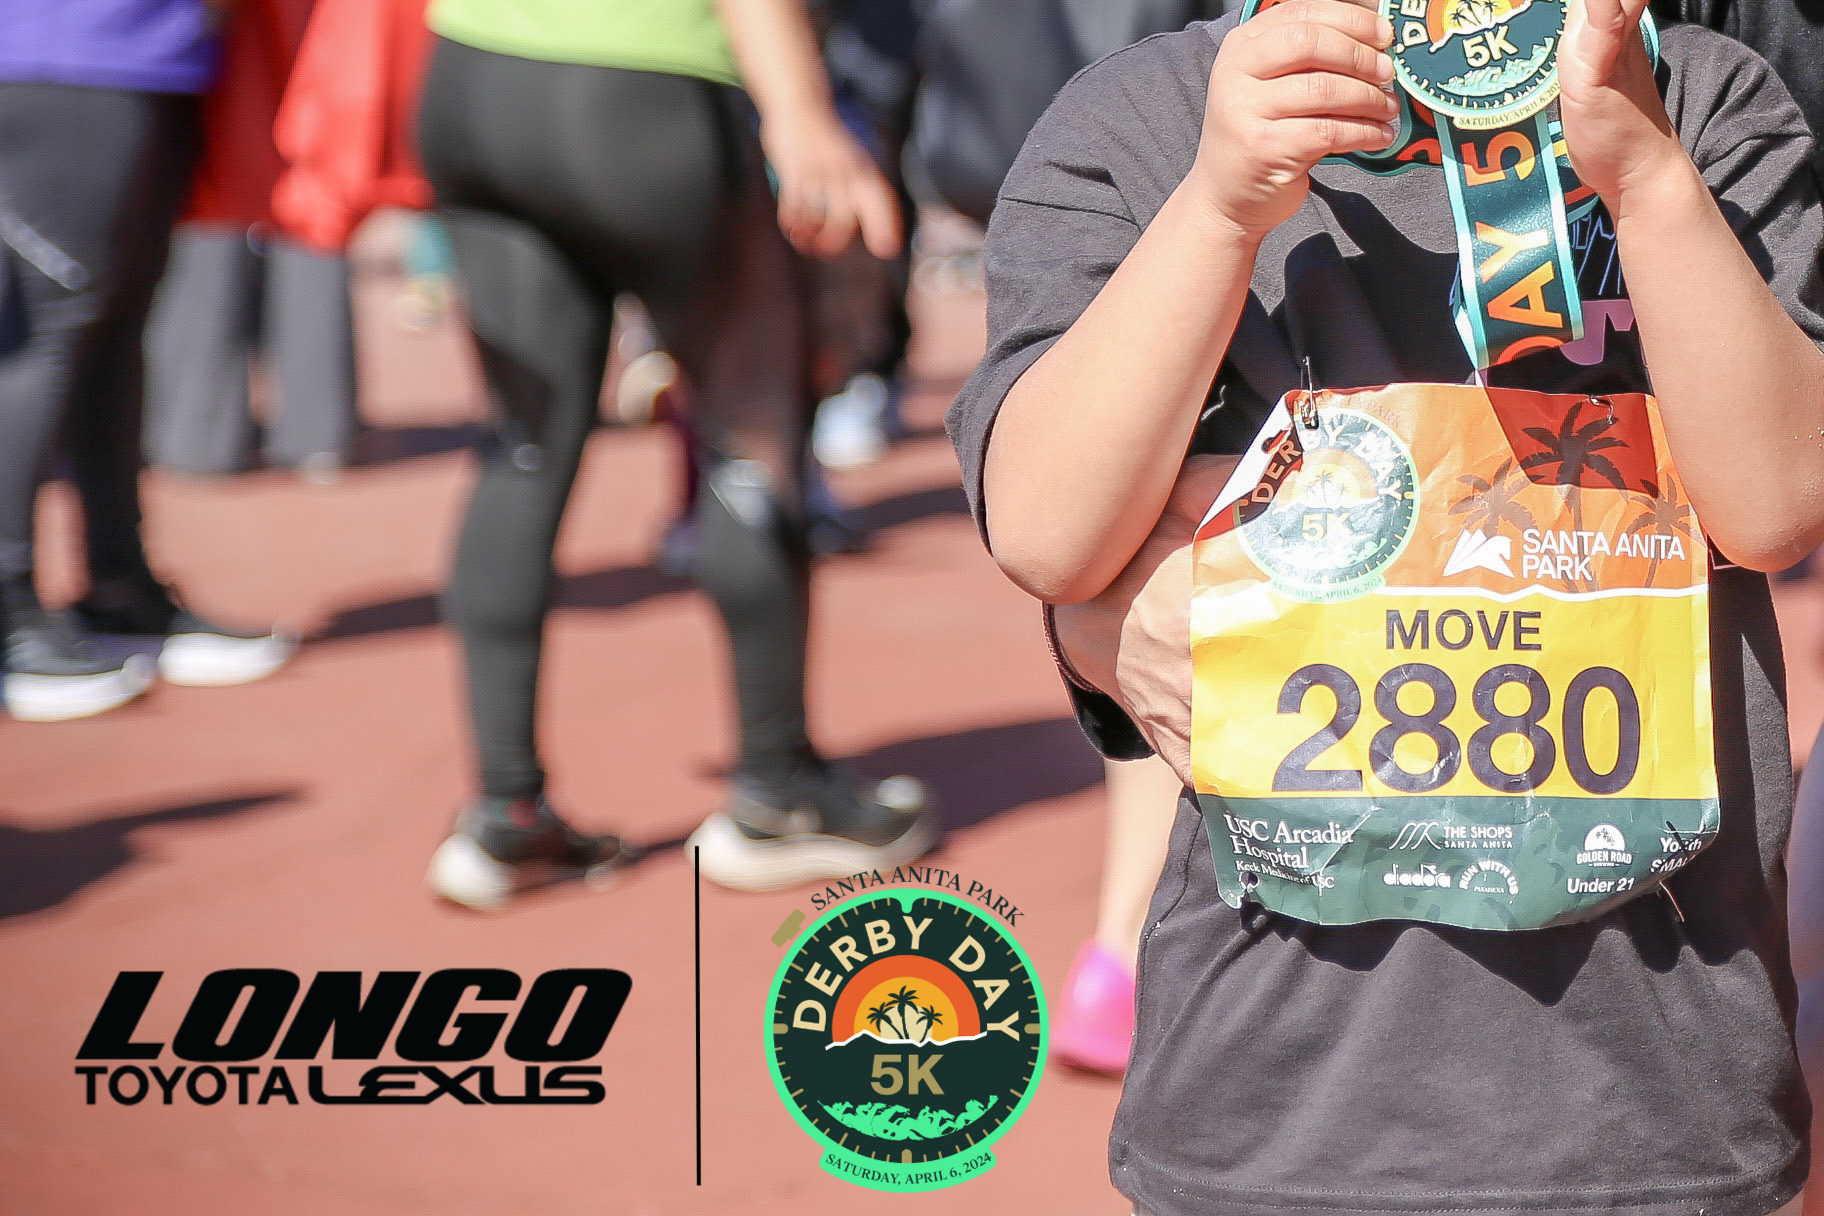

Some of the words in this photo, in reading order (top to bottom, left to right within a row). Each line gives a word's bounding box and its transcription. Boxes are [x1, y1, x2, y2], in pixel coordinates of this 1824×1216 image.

[1462, 25, 1518, 67] 5K
[1251, 424, 1345, 504] DERBY
[1352, 431, 1403, 502] DAY
[1301, 512, 1352, 542] 5K
[1522, 528, 1611, 557] SANTA
[1615, 532, 1686, 561] ANITA
[1522, 554, 1594, 581] PARK
[1363, 576, 1383, 591] 2024
[1385, 609, 1543, 651] MOVE
[1271, 662, 1642, 796] 2880
[1223, 813, 1270, 843] USC
[1272, 820, 1354, 844] Arcadia
[1443, 826, 1468, 839] THE
[1470, 826, 1513, 839] SHOPS
[1230, 835, 1310, 869] Hospital
[1444, 840, 1478, 849] SANTA
[1482, 840, 1513, 849] ANITA
[1576, 851, 1610, 865] GOLDEN
[1610, 851, 1633, 865] ROAD
[1235, 860, 1261, 873] Keck
[1311, 875, 1335, 889] USC
[1383, 862, 1451, 888] diadora
[1458, 864, 1479, 890] RUN
[1477, 860, 1512, 879] WITH
[1506, 875, 1520, 896] US
[1567, 878, 1615, 894] Under
[1616, 877, 1635, 892] 21
